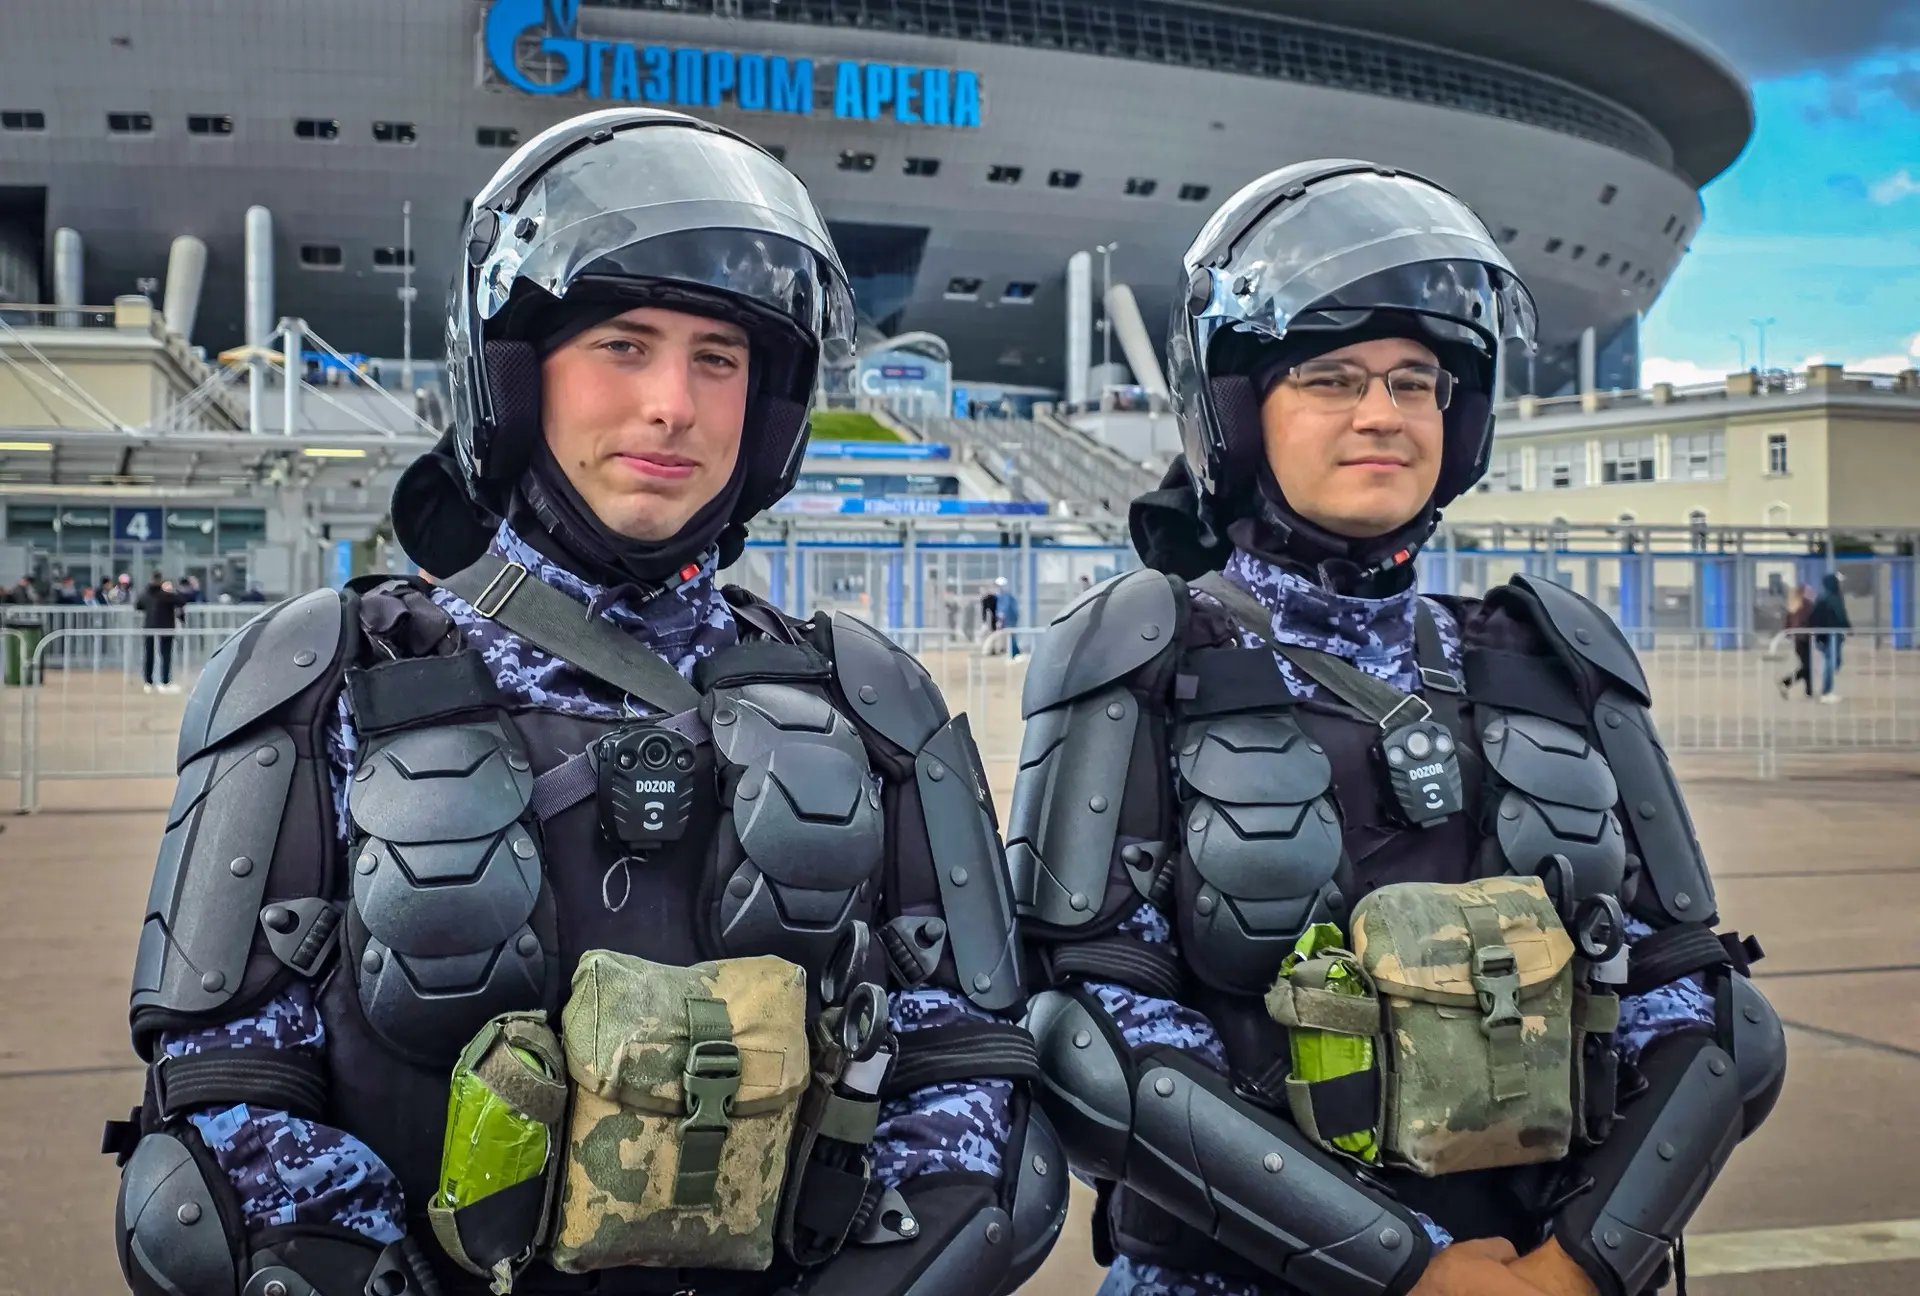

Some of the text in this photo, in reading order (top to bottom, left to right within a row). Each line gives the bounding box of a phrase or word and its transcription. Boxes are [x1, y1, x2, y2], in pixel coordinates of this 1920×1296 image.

[587, 41, 981, 127] ГАЗПРОМ АРЕНА
[126, 512, 151, 541] 4
[1409, 762, 1444, 781] DOZOR
[636, 780, 675, 793] DOZOR
